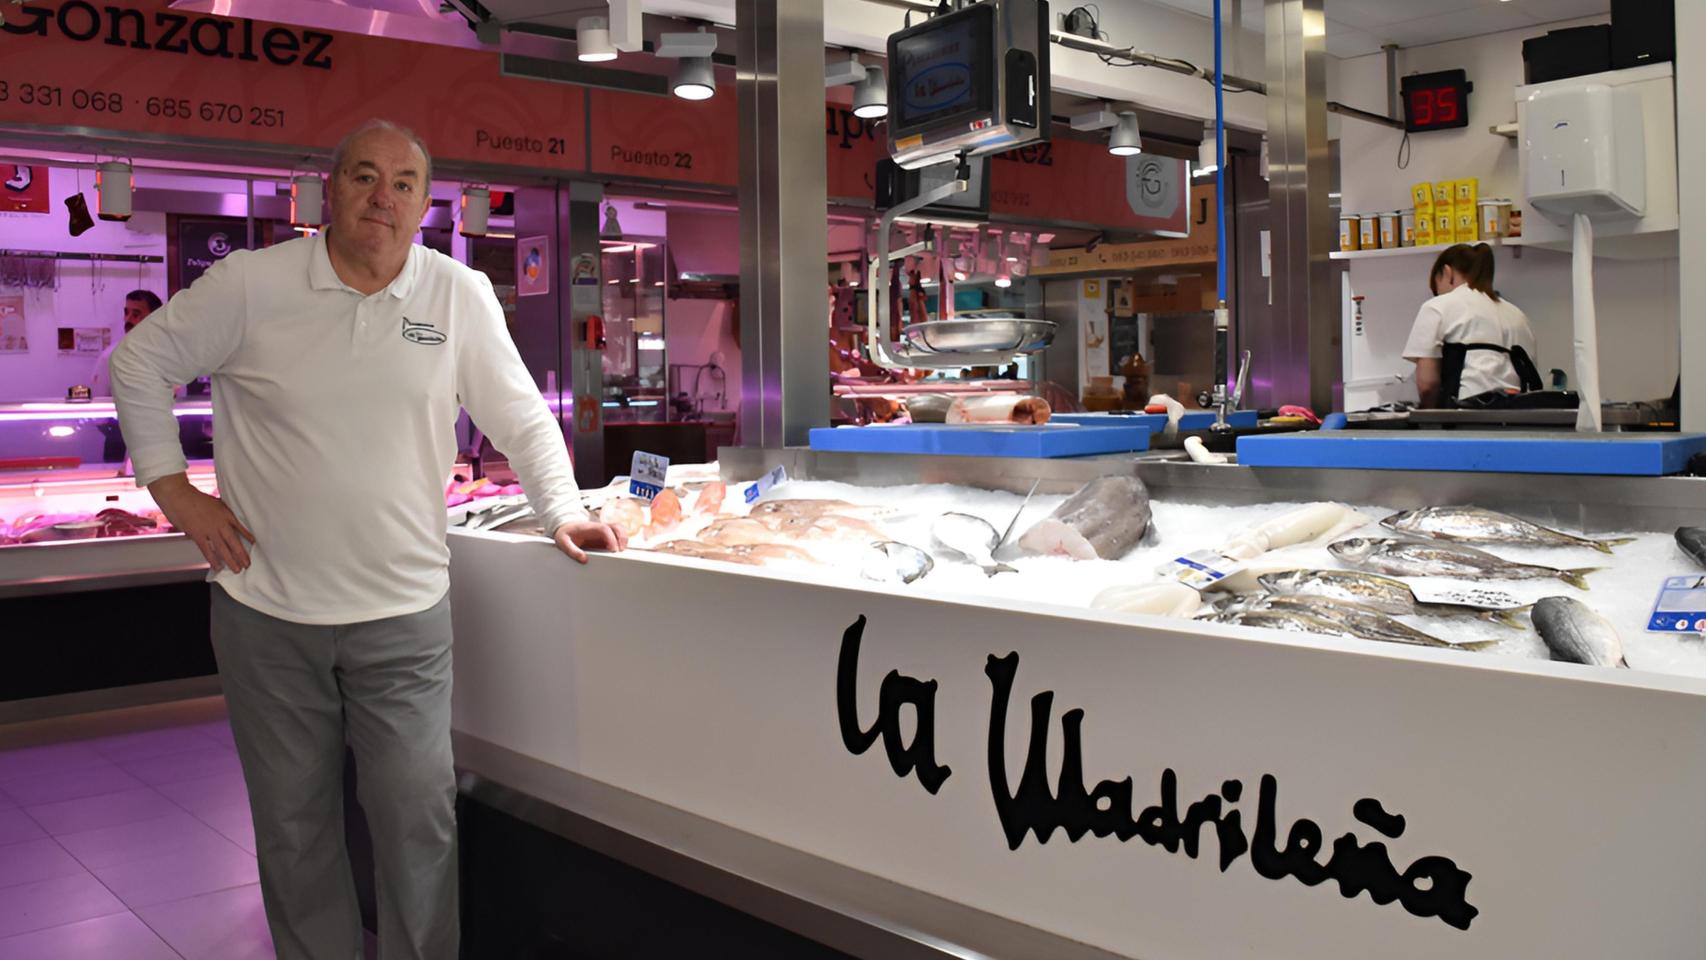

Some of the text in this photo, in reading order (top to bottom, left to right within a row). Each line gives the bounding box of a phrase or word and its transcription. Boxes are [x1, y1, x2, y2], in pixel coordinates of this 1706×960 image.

[19, 83, 62, 107] 331
[72, 89, 123, 114] 068
[146, 97, 192, 119] 685
[200, 103, 243, 123] 670
[250, 107, 285, 128] 251
[1411, 87, 1457, 125] 35
[476, 130, 565, 154] Puesto 21
[611, 146, 692, 169] Puesto 22
[984, 651, 1479, 931] Madrileña
